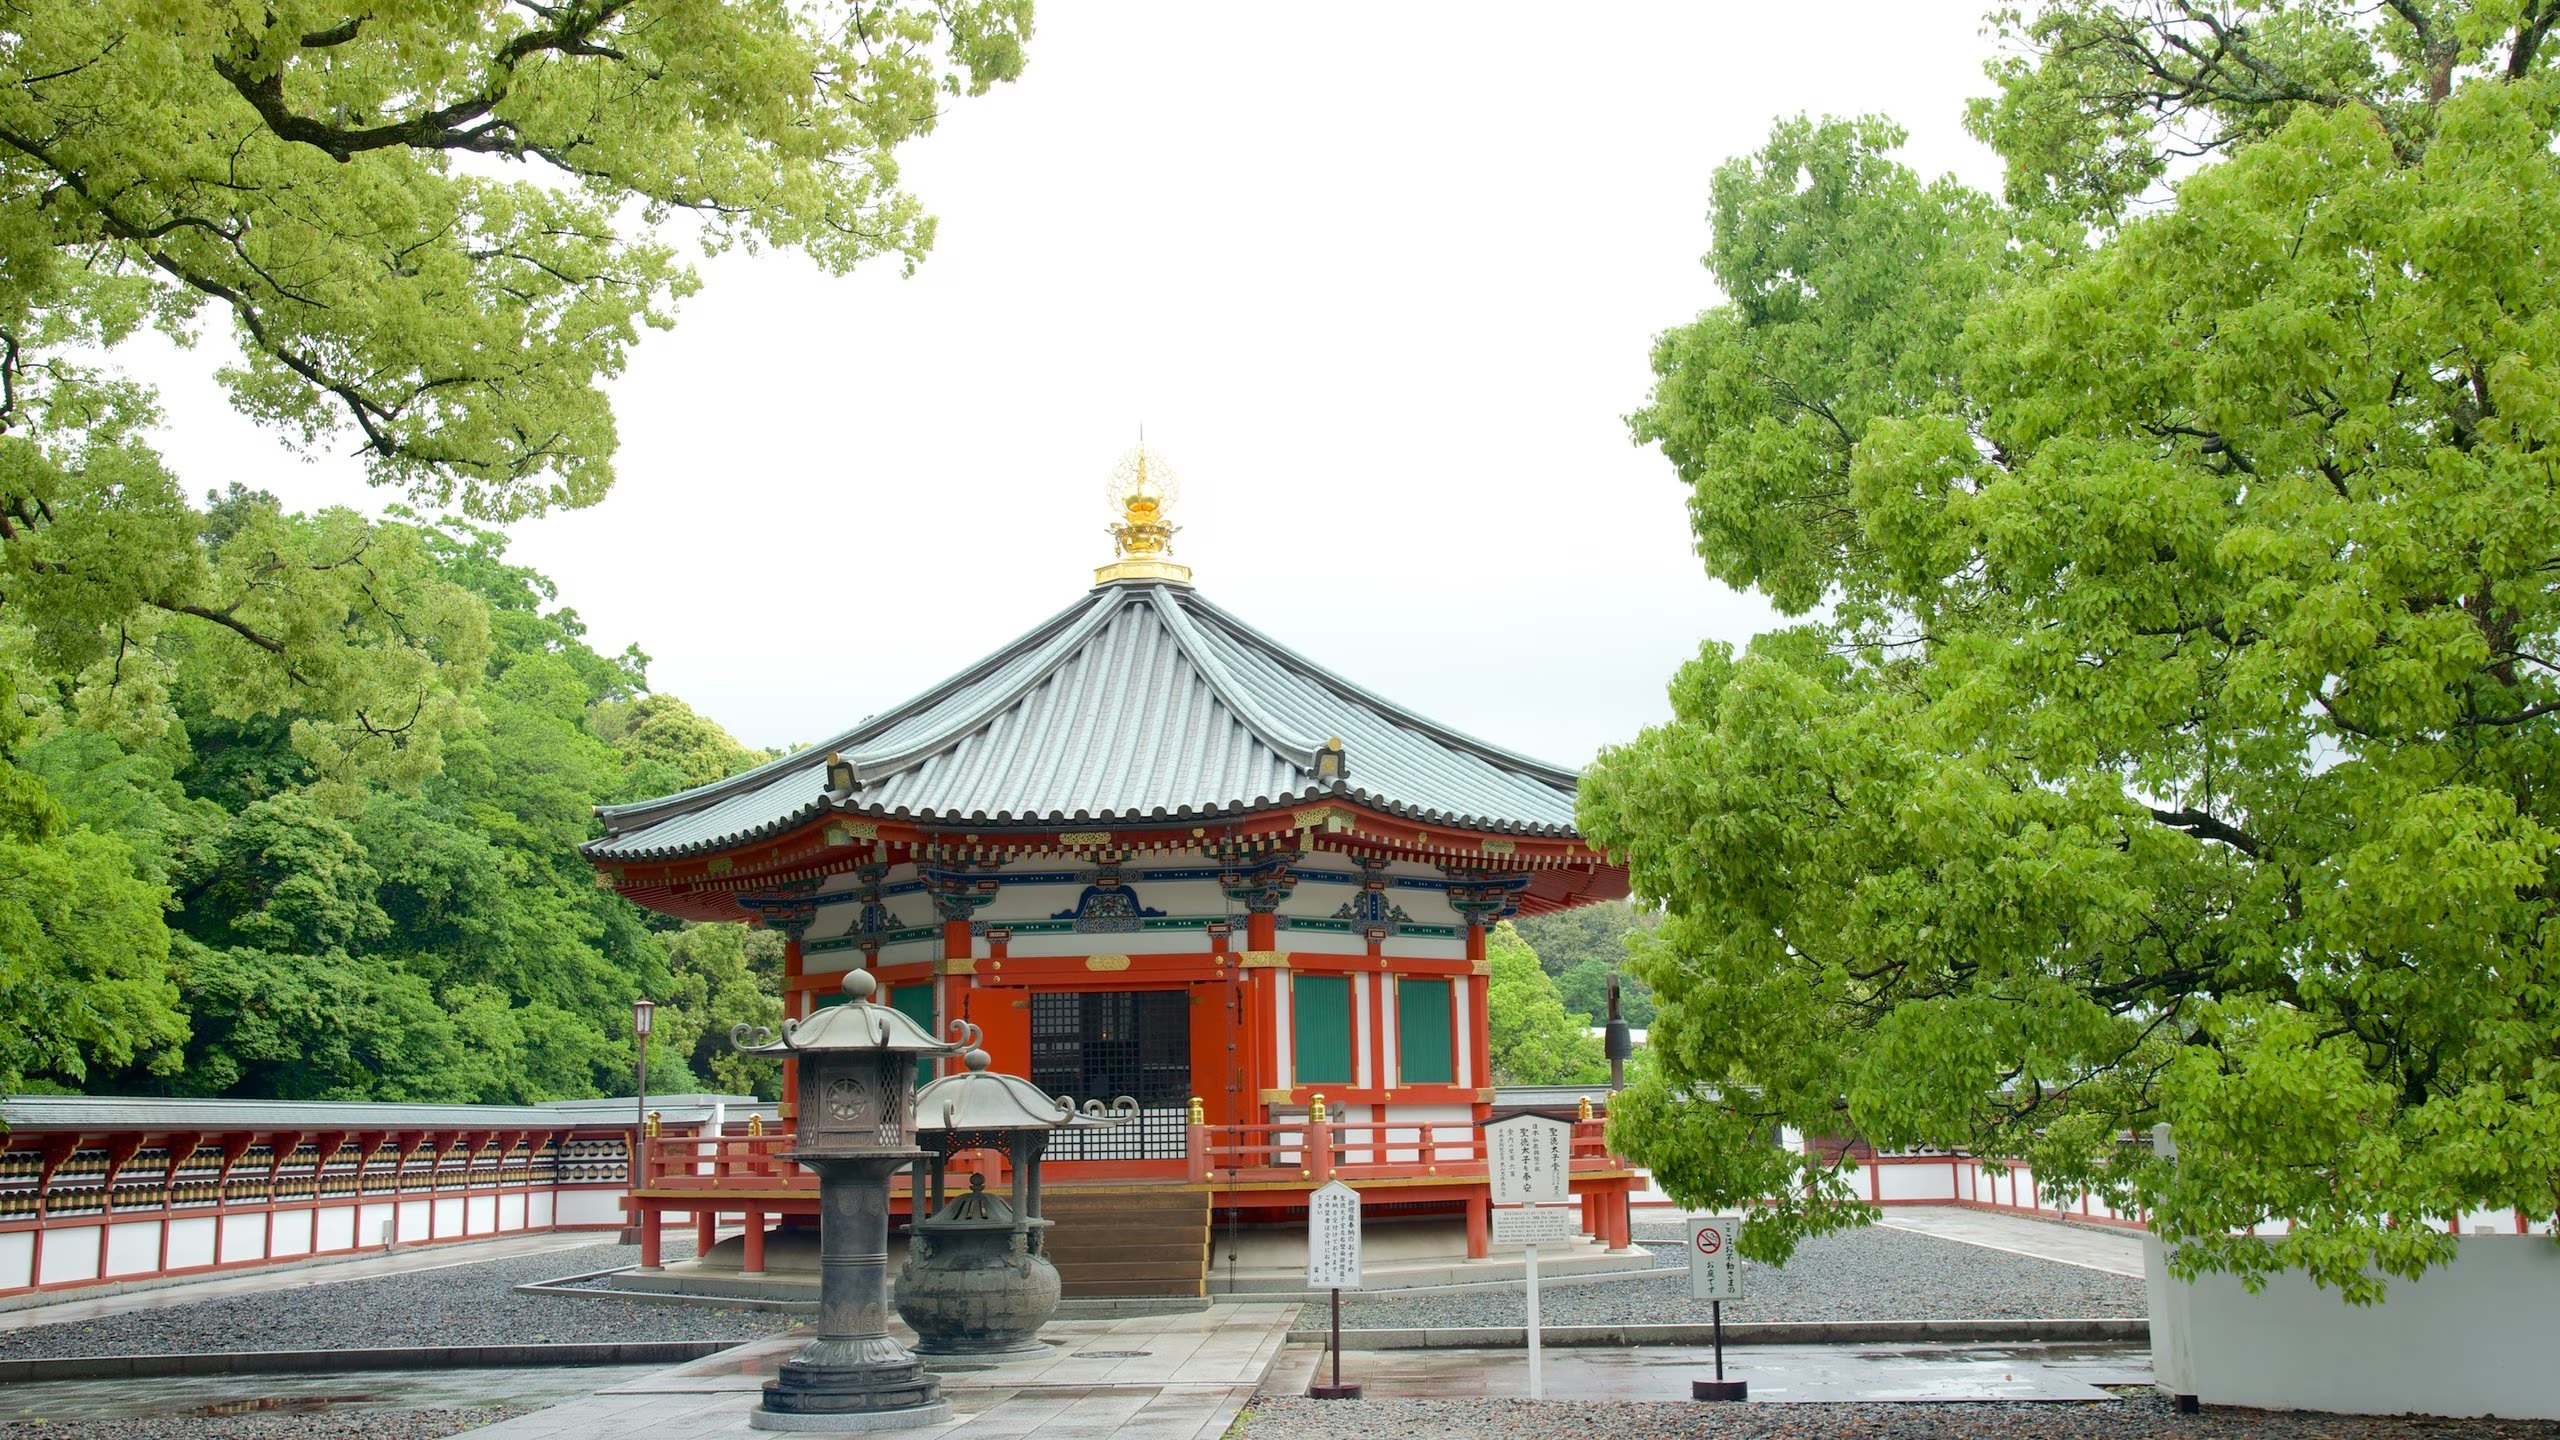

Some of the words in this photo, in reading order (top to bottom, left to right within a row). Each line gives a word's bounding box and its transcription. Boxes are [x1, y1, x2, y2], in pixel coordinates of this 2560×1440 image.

[1519, 1128, 1532, 1193] 聖徳太子を奉安
[1548, 1127, 1560, 1171] 聖徳太子堂
[1725, 1222, 1735, 1294] ここはお不動さまの
